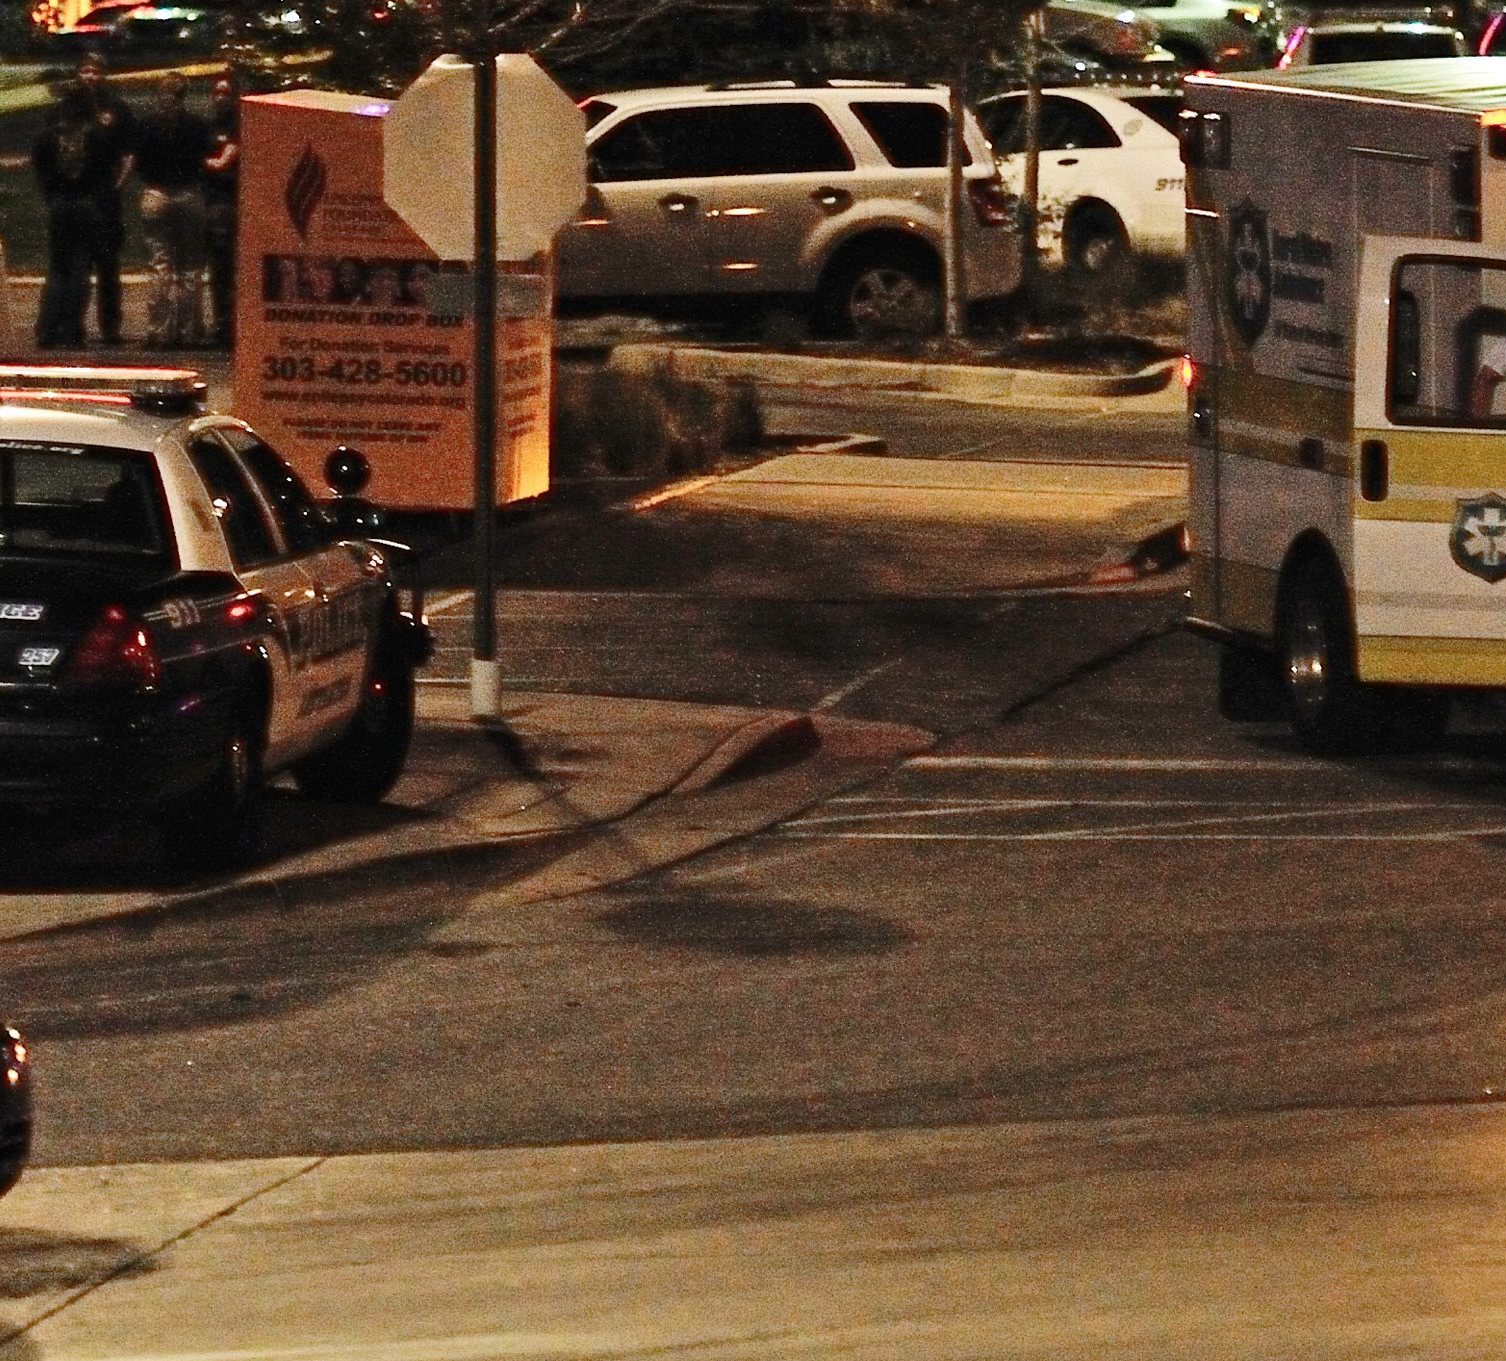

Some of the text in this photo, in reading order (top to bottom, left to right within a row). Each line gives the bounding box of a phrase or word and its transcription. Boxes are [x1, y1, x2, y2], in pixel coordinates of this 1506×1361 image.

[264, 308, 362, 325] DONATION
[369, 311, 422, 326] DROP
[263, 356, 467, 387] 303-428-5600
